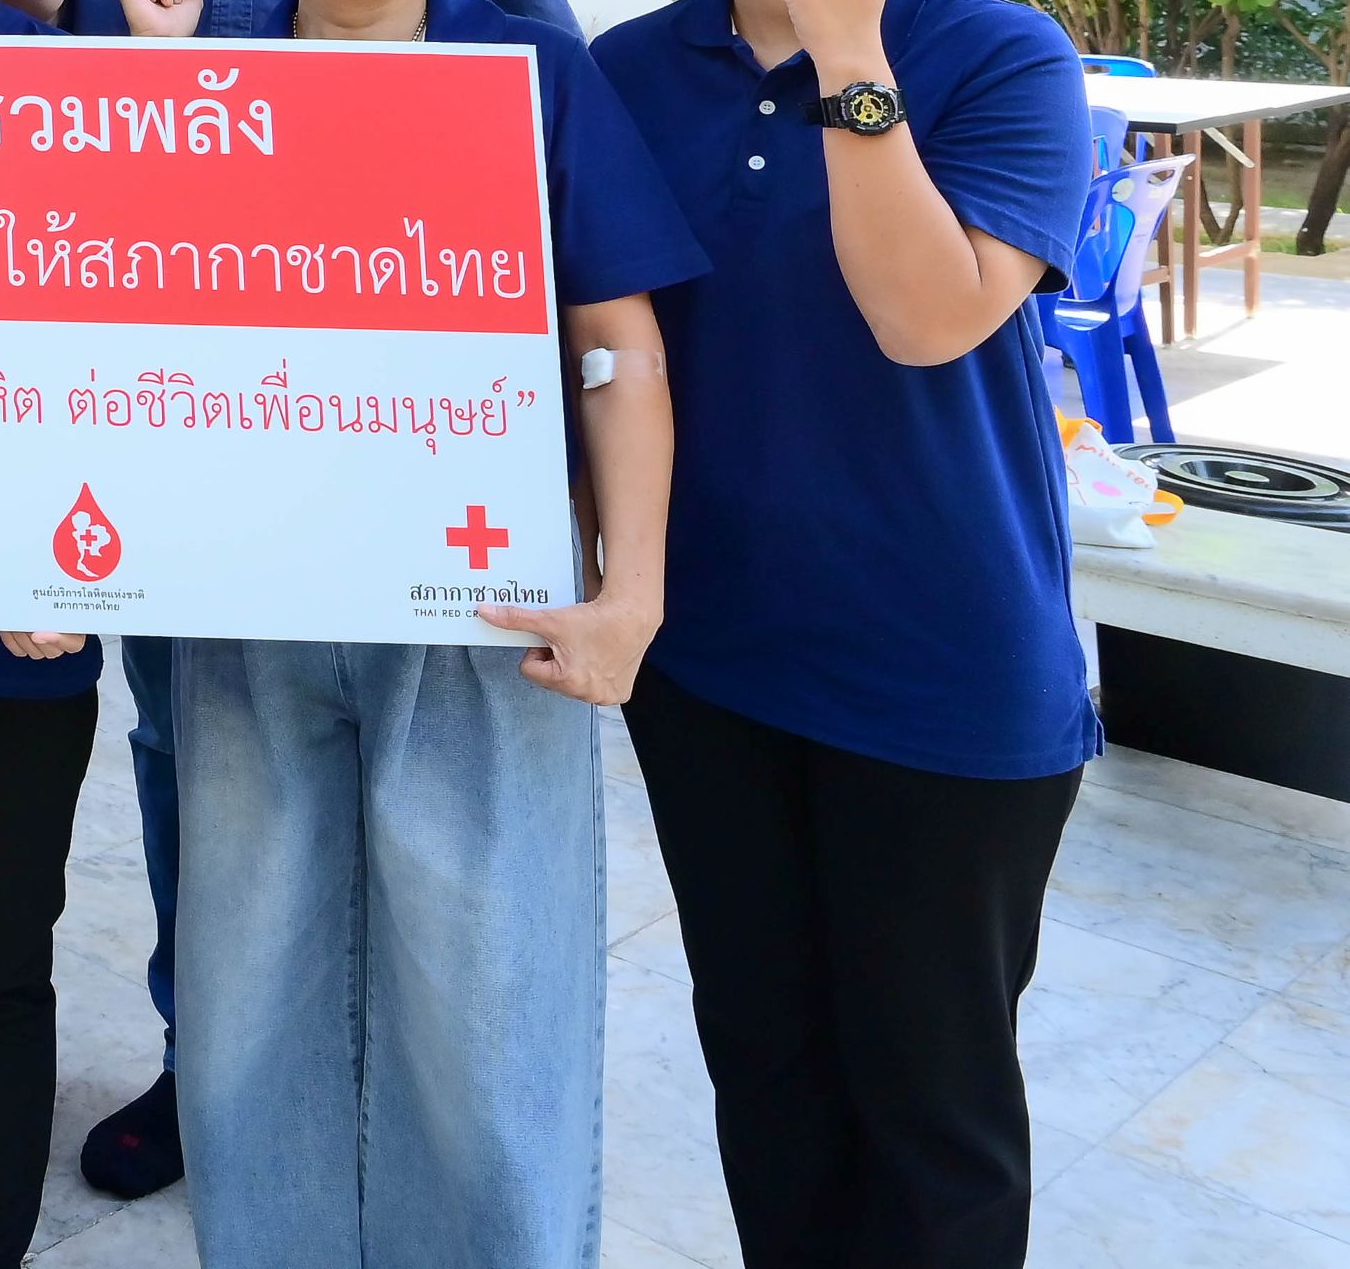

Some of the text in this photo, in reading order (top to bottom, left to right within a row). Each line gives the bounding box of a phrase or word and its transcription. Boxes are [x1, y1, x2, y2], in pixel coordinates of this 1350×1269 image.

[410, 580, 549, 604] สภากาชาดไทย
[53, 600, 120, 611] สภากาชาดไทย
[413, 608, 437, 617] THAI
[442, 609, 461, 617] RED
